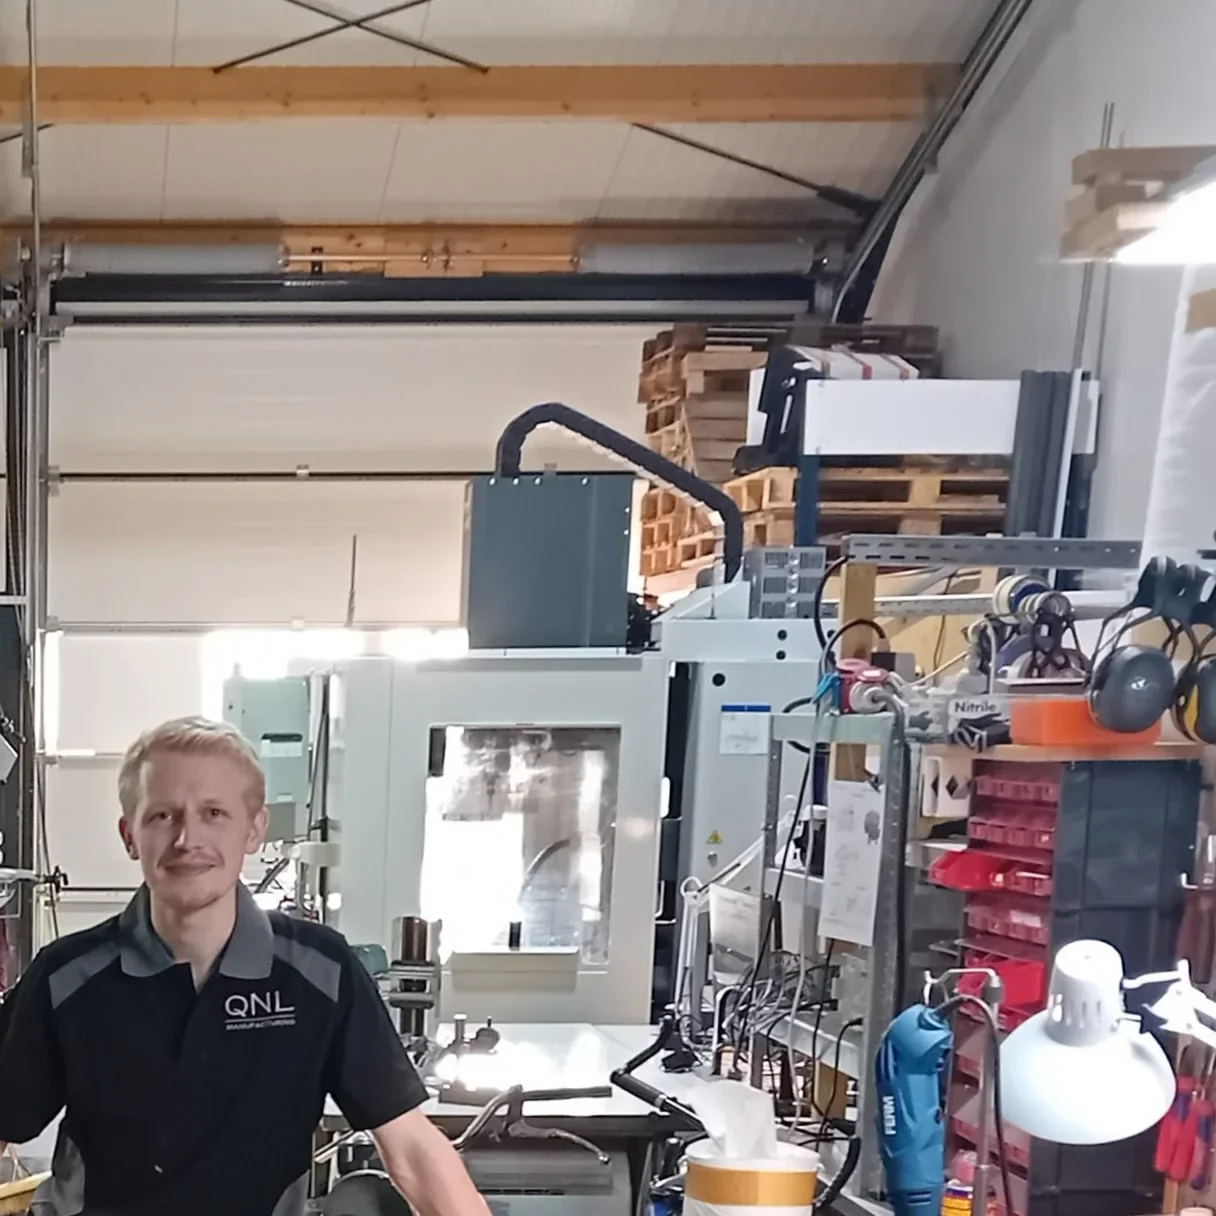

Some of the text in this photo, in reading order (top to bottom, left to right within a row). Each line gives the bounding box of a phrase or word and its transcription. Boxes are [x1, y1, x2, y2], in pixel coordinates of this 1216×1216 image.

[955, 701, 996, 712] Nitrile
[225, 990, 295, 1017] QNL
[883, 1095, 896, 1135] FERM
